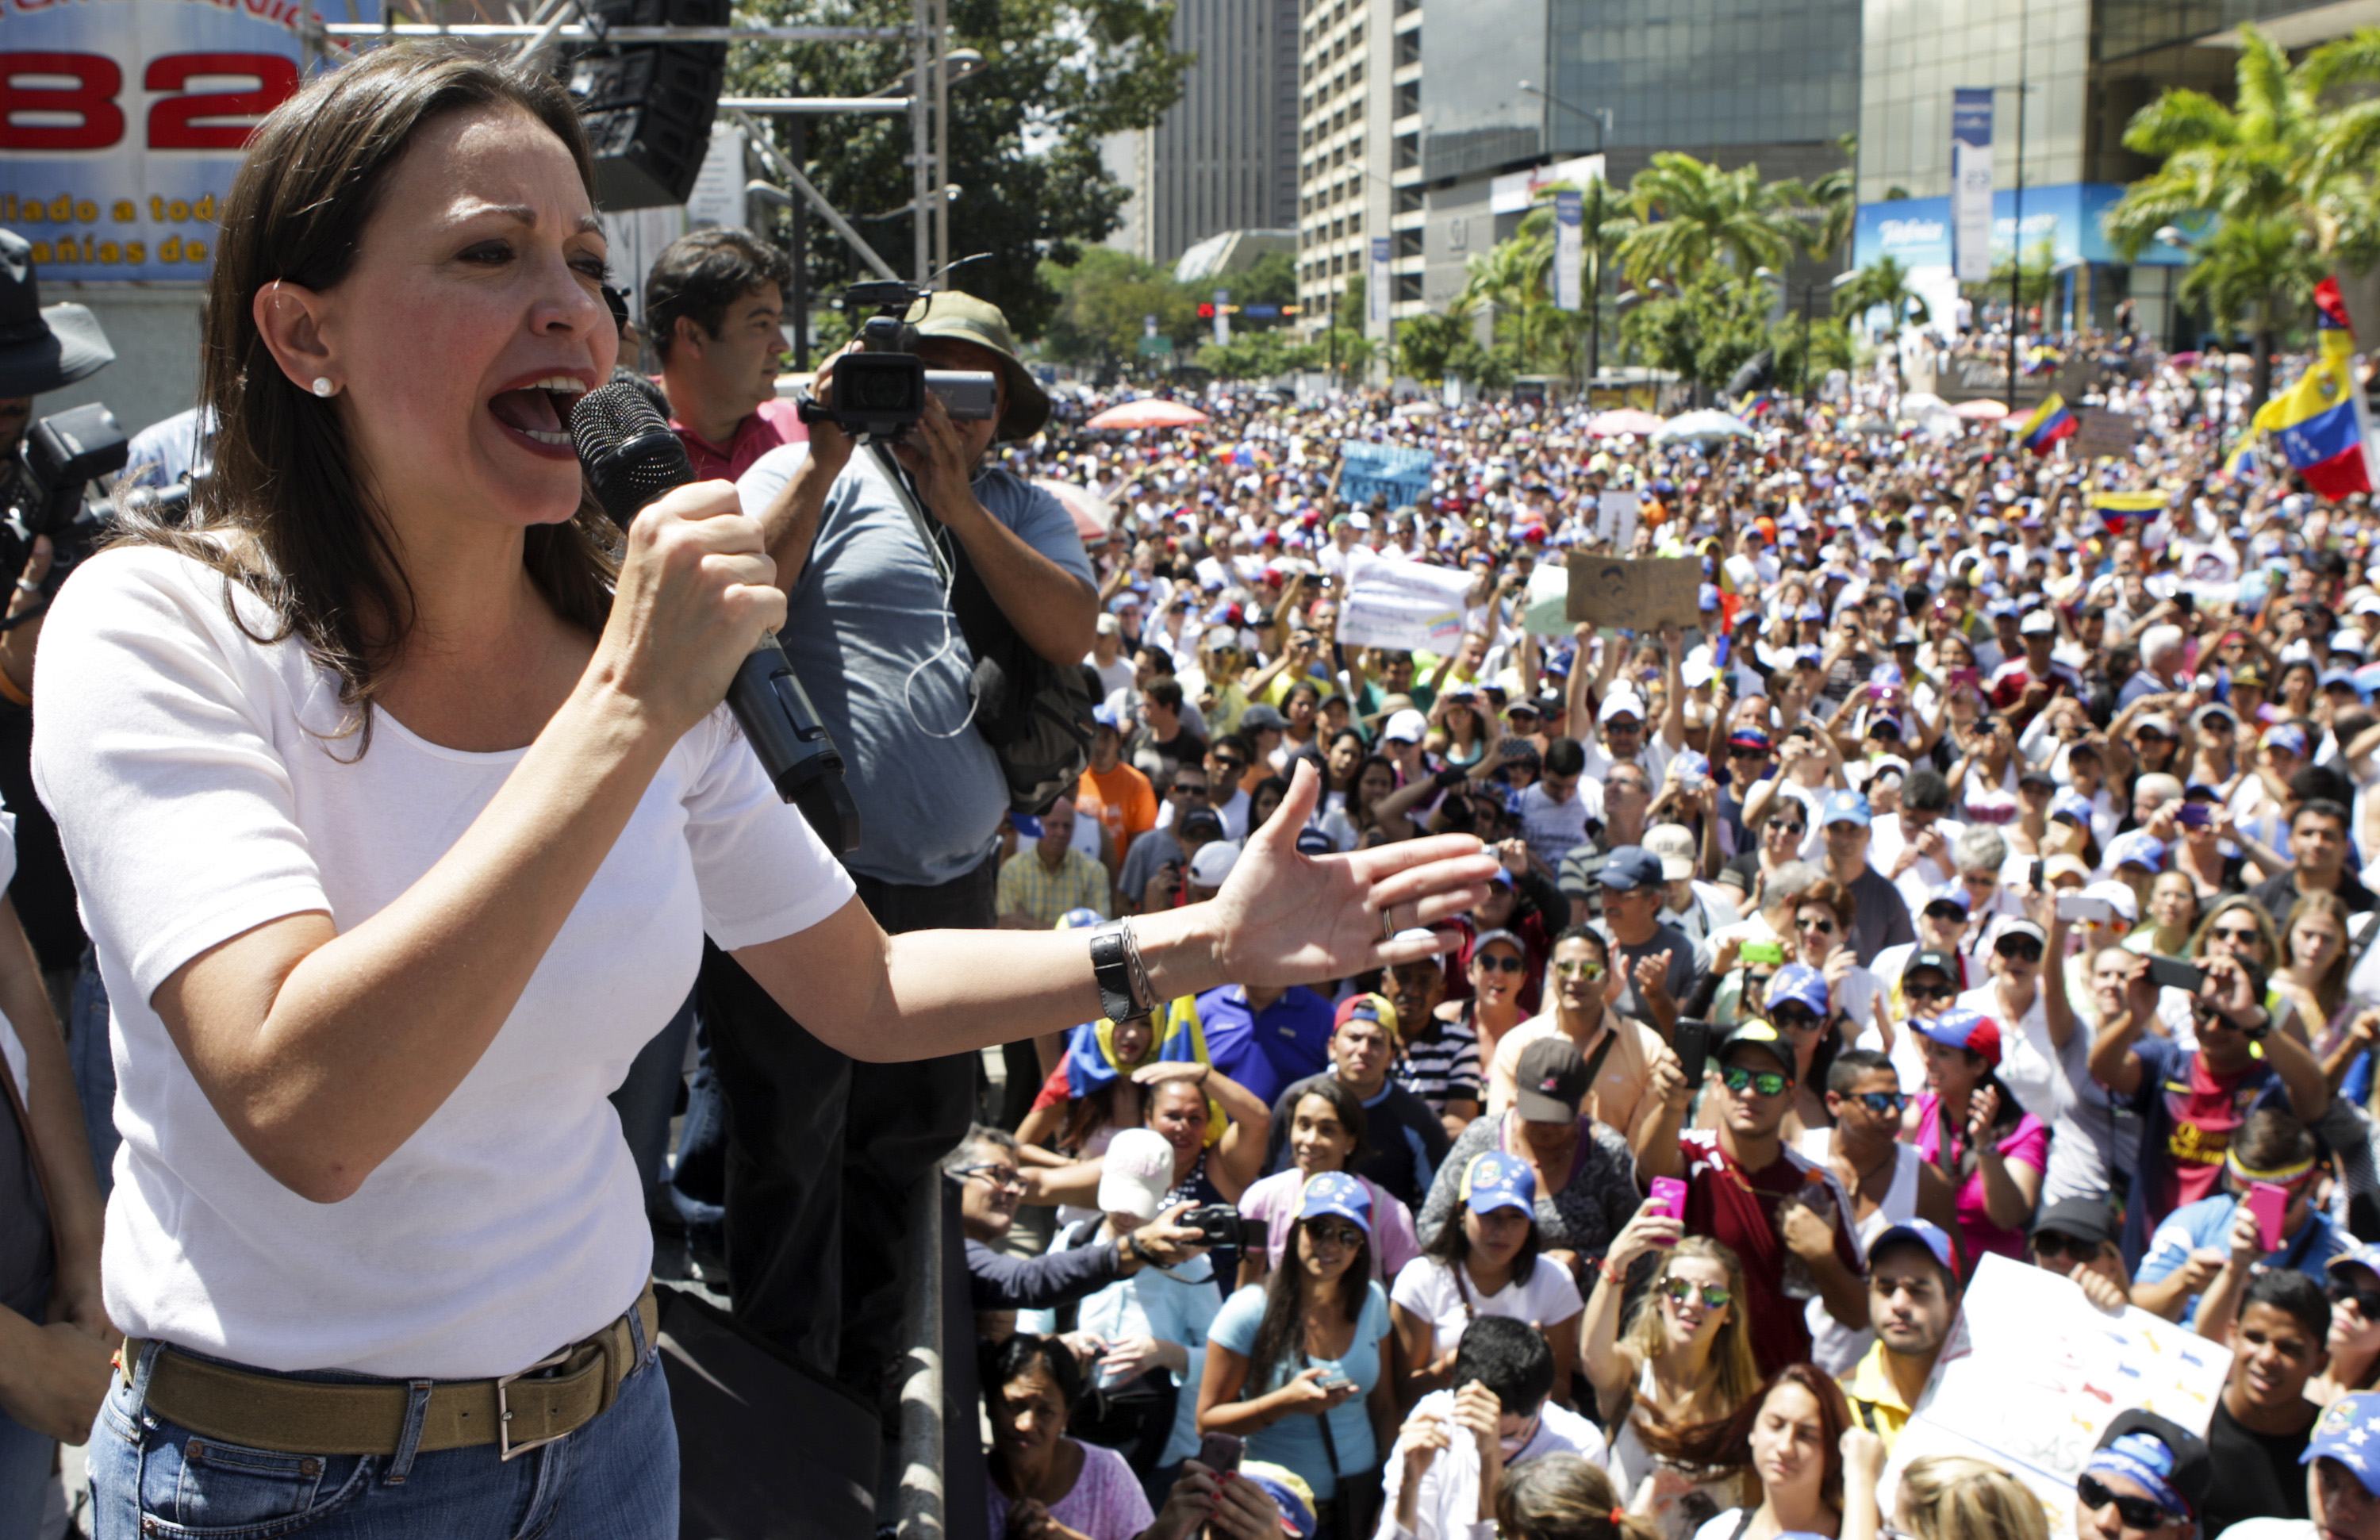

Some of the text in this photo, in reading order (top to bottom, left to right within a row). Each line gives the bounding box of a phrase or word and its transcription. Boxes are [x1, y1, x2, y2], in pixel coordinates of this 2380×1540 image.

[113, 200, 136, 223] a
[31, 233, 207, 264] añías de
